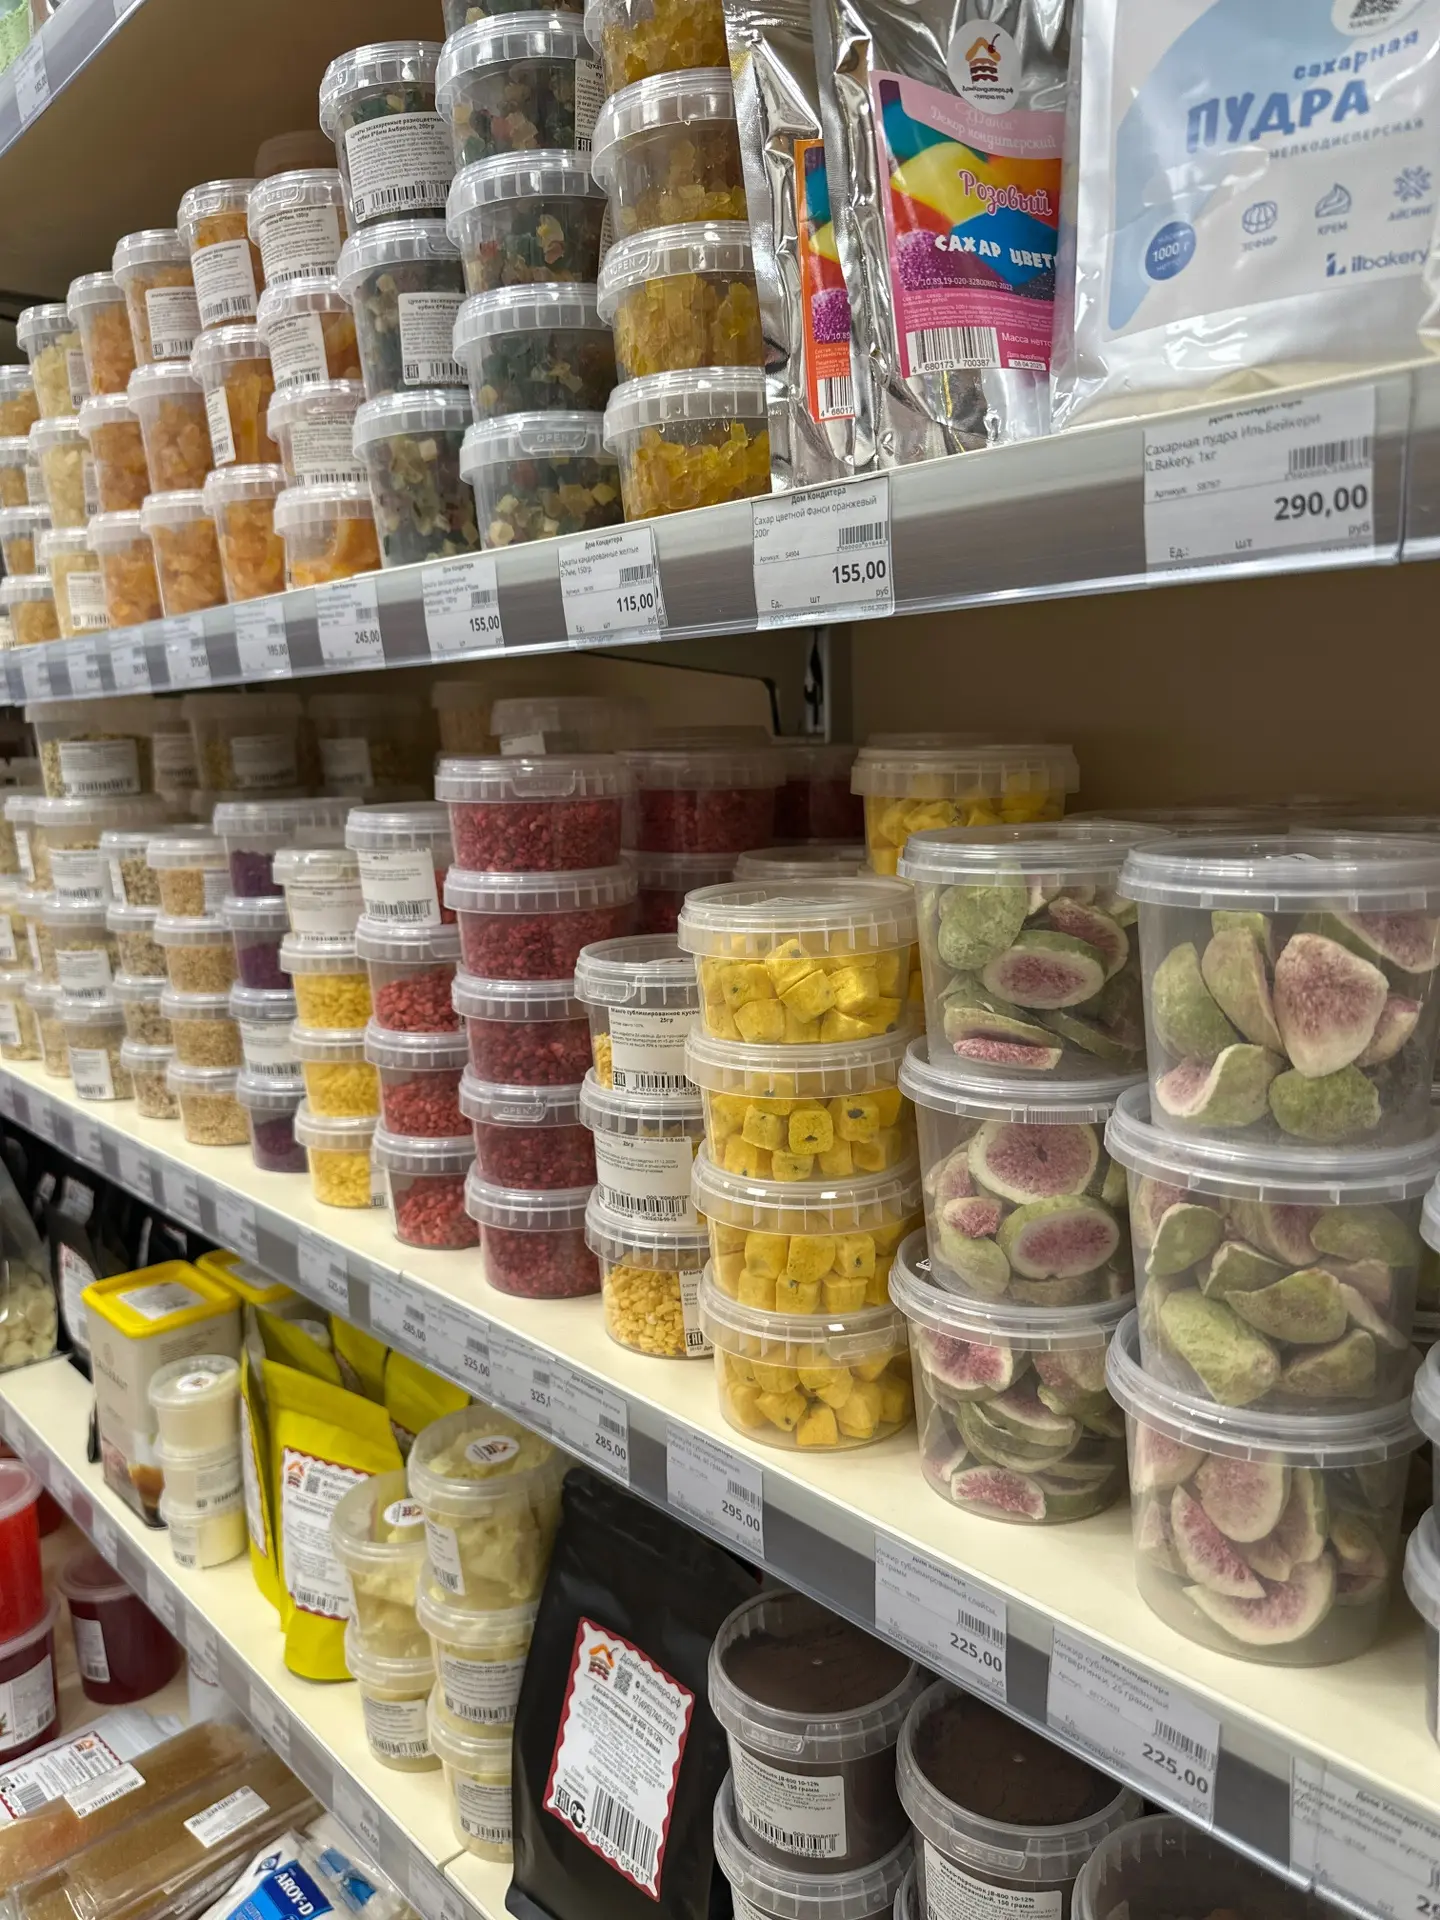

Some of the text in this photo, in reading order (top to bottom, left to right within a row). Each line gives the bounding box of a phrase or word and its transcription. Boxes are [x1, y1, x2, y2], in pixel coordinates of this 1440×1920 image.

[1294, 29, 1420, 80] сахарная
[1187, 79, 1370, 154] ПУДРА
[931, 105, 1056, 154] Декор кондитерский
[1269, 118, 1424, 160] МЕЛКОДИСПЕРСНАЯ
[958, 169, 1053, 216] Розовый
[1317, 221, 1348, 236] КРЕМ
[934, 234, 1002, 259] САХАР
[1152, 242, 1180, 263] 1000
[1001, 332, 1029, 343] Масса
[925, 361, 955, 371] 680173
[963, 359, 990, 368] 700387
[536, 432, 569, 443] OPEN
[1146, 436, 1200, 457] Сахарная
[1202, 429, 1238, 447] пудра
[1199, 450, 1217, 463] 1кг
[791, 486, 847, 505] Дом Кондитера
[1274, 484, 1368, 521] 290,00
[754, 496, 877, 526] Сахар цветной Фанси оранжевый
[596, 536, 623, 547] Кондитера
[1349, 521, 1370, 538] руб
[1235, 538, 1253, 550] шт
[832, 560, 886, 584] 155,00
[617, 593, 654, 612] 115,00
[810, 595, 820, 604] шт
[875, 586, 889, 597] руб
[470, 615, 500, 632] 155,00
[355, 630, 380, 644] 245,00
[402, 1319, 427, 1343] 285,00
[463, 1354, 490, 1378] 325,00
[595, 1432, 627, 1460] 285,00
[722, 1500, 760, 1532] 295,00
[950, 1632, 1002, 1672] 225,00
[1054, 1636, 1084, 1661] Инжир
[620, 1652, 682, 1710] ДомКондитера.рф
[1142, 1742, 1208, 1795] 225,00
[274, 1872, 314, 1916] AROY-D
[1010, 1902, 1035, 1910] грамм
